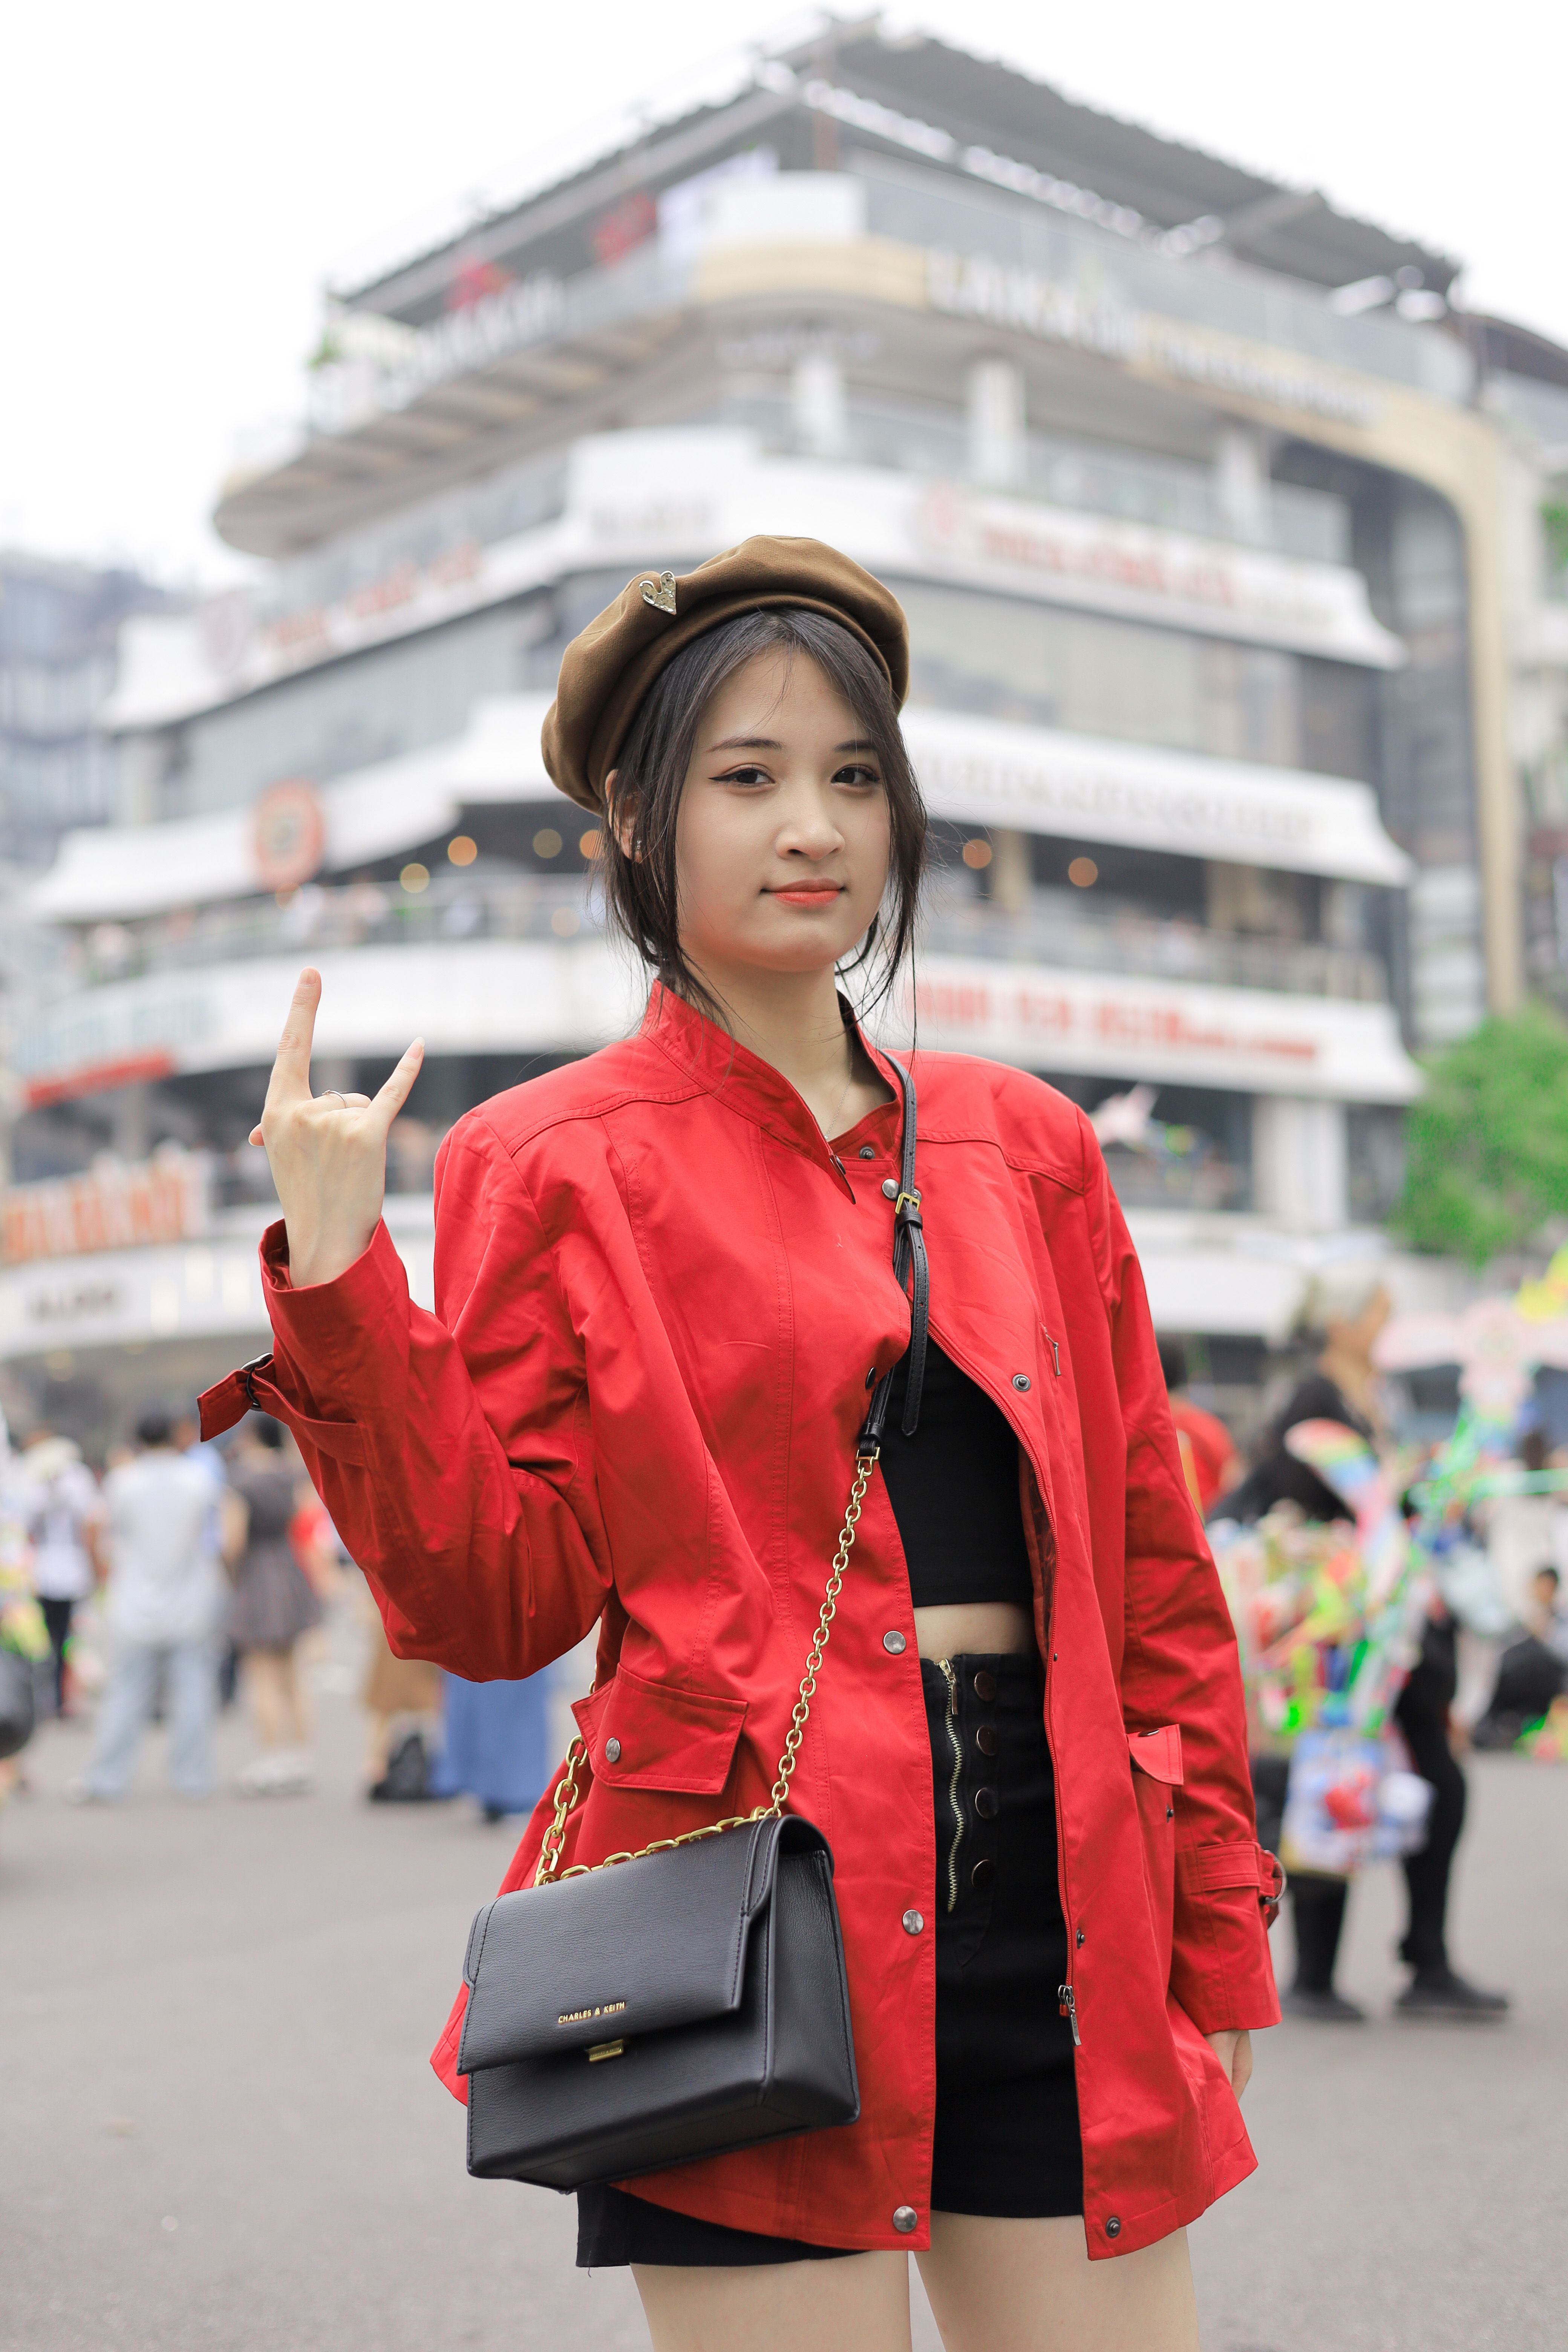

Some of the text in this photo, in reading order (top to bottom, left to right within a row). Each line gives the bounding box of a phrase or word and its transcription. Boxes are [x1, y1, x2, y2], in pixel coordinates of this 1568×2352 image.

[558, 2001, 625, 2023] CHARLES & KEITH
